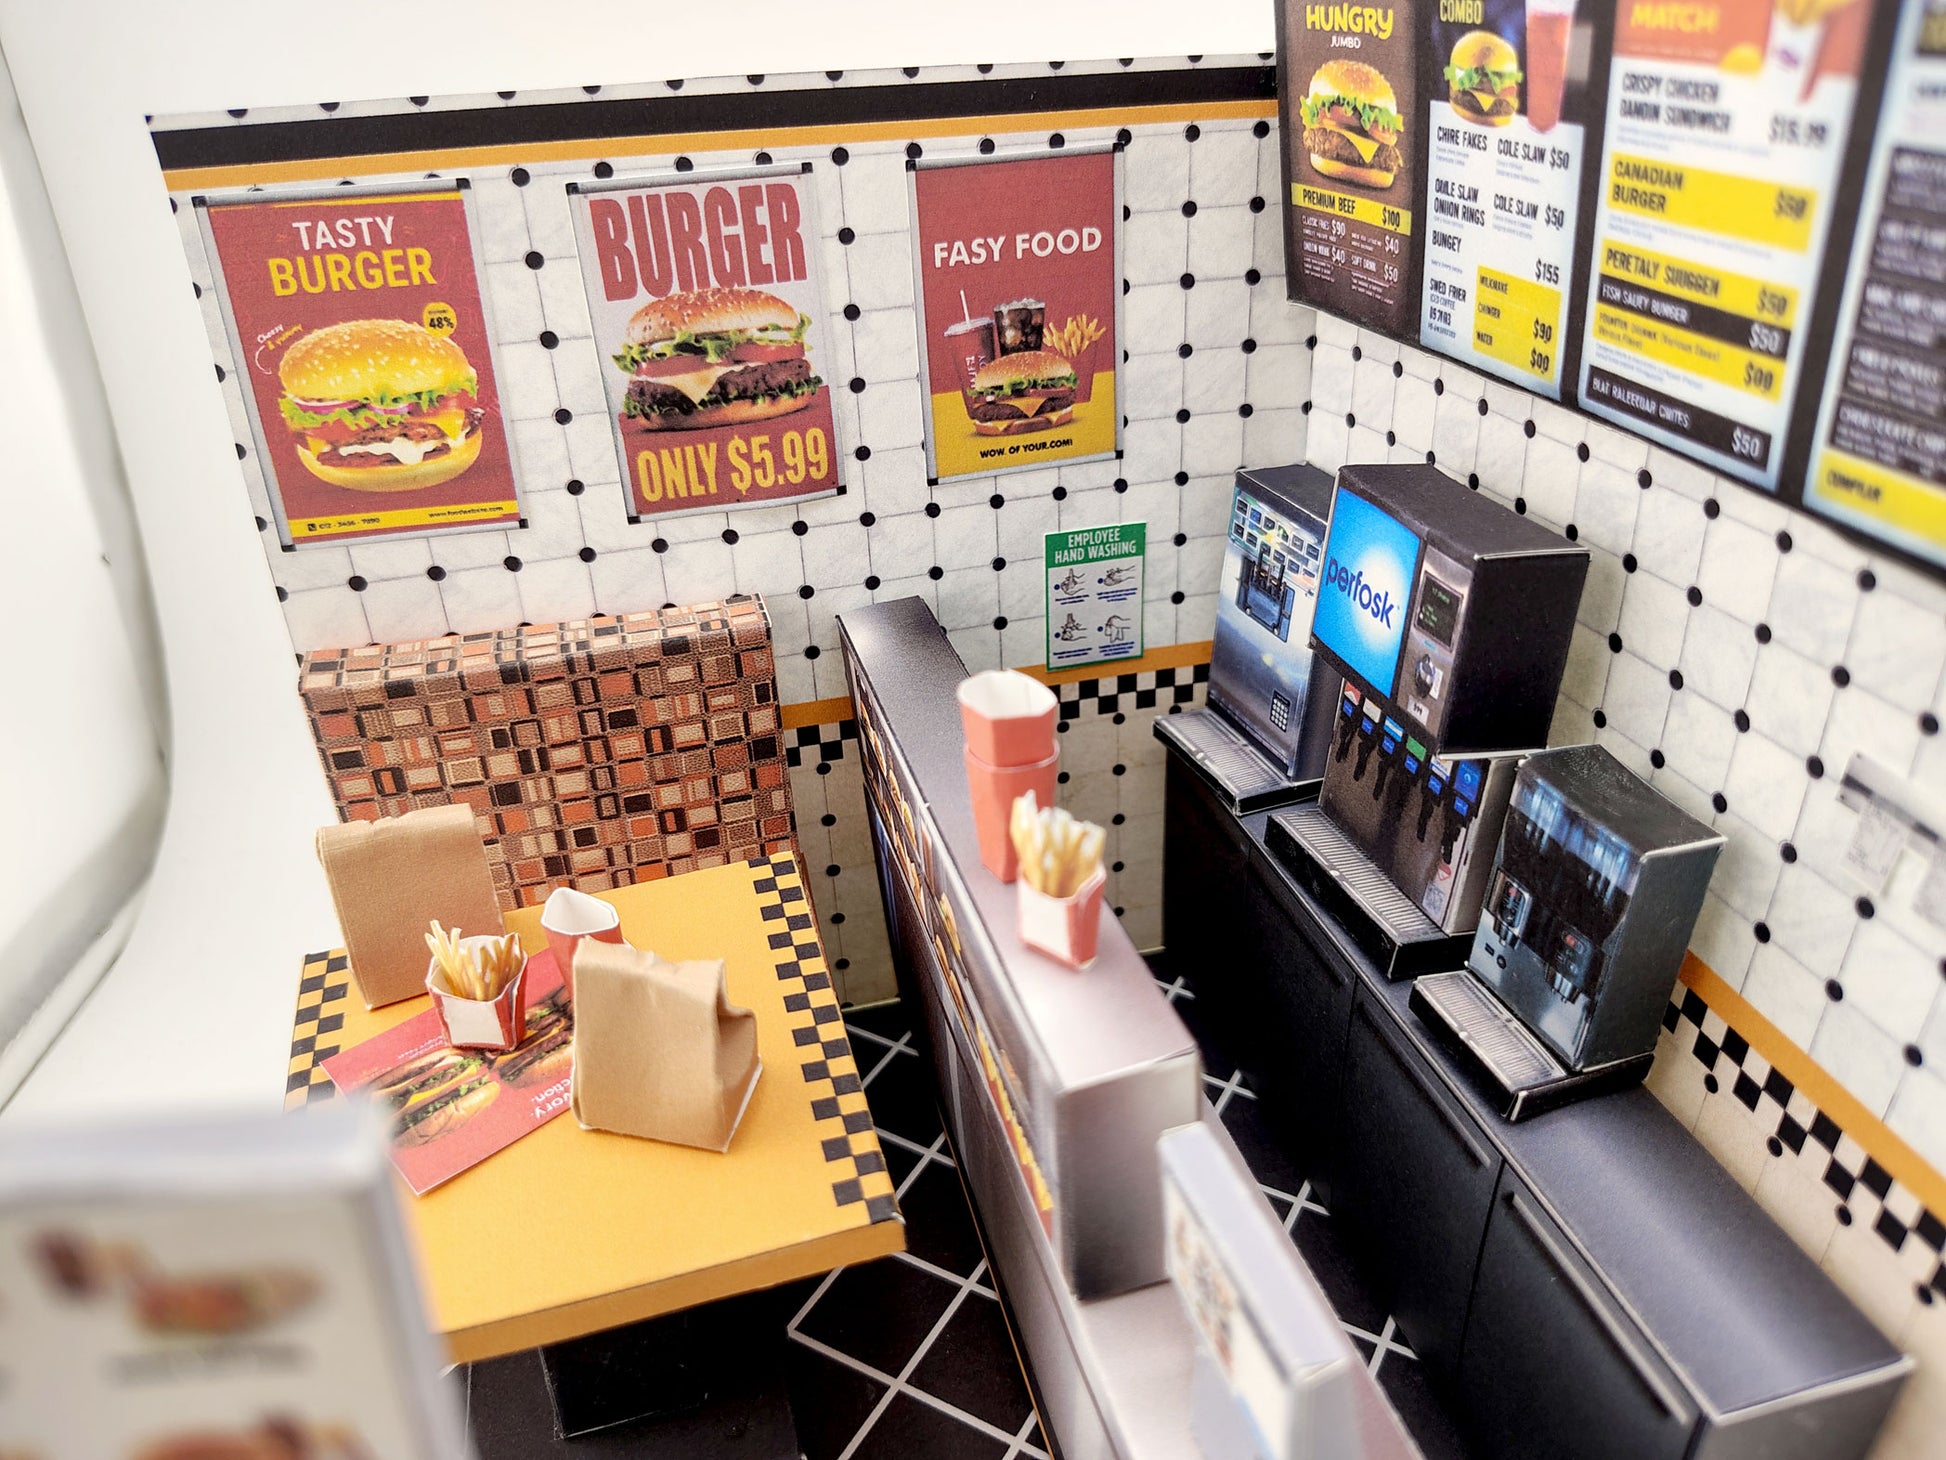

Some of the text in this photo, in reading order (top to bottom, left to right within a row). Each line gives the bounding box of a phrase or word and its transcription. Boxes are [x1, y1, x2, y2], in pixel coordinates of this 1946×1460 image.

[1306, 2, 1393, 39] HUNGRY
[1440, 0, 1482, 24] COMBO
[1330, 36, 1361, 48] JUMBO
[1462, 132, 1487, 152] FAKES
[1497, 138, 1570, 170] COLE SLAW $50
[1615, 161, 1684, 190] CANADIAN
[1457, 184, 1479, 203] SLAW
[1612, 184, 1667, 213] BURGER
[1303, 189, 1400, 229] PREMIUM BEEF $100
[1461, 205, 1485, 227] RINGS
[1493, 193, 1513, 214] COLE
[1515, 199, 1538, 220] SLAW
[1545, 204, 1564, 229] $50
[292, 215, 395, 251] TASTY
[1332, 219, 1346, 236] $90
[589, 183, 807, 302] BURGER
[933, 227, 1102, 268] FASY FOOD
[1384, 235, 1399, 254] $40
[267, 248, 437, 297] BURGER
[1384, 262, 1399, 283] $50
[1535, 258, 1560, 285] $155
[429, 316, 454, 329] 48%
[1008, 446, 1020, 454] OF
[1731, 427, 1760, 457] $50
[637, 427, 829, 502] ONLY $5.99
[1068, 528, 1121, 548] EMPLOYEE
[1055, 541, 1137, 564] HAND WASHING
[1326, 557, 1391, 630] perfosk
